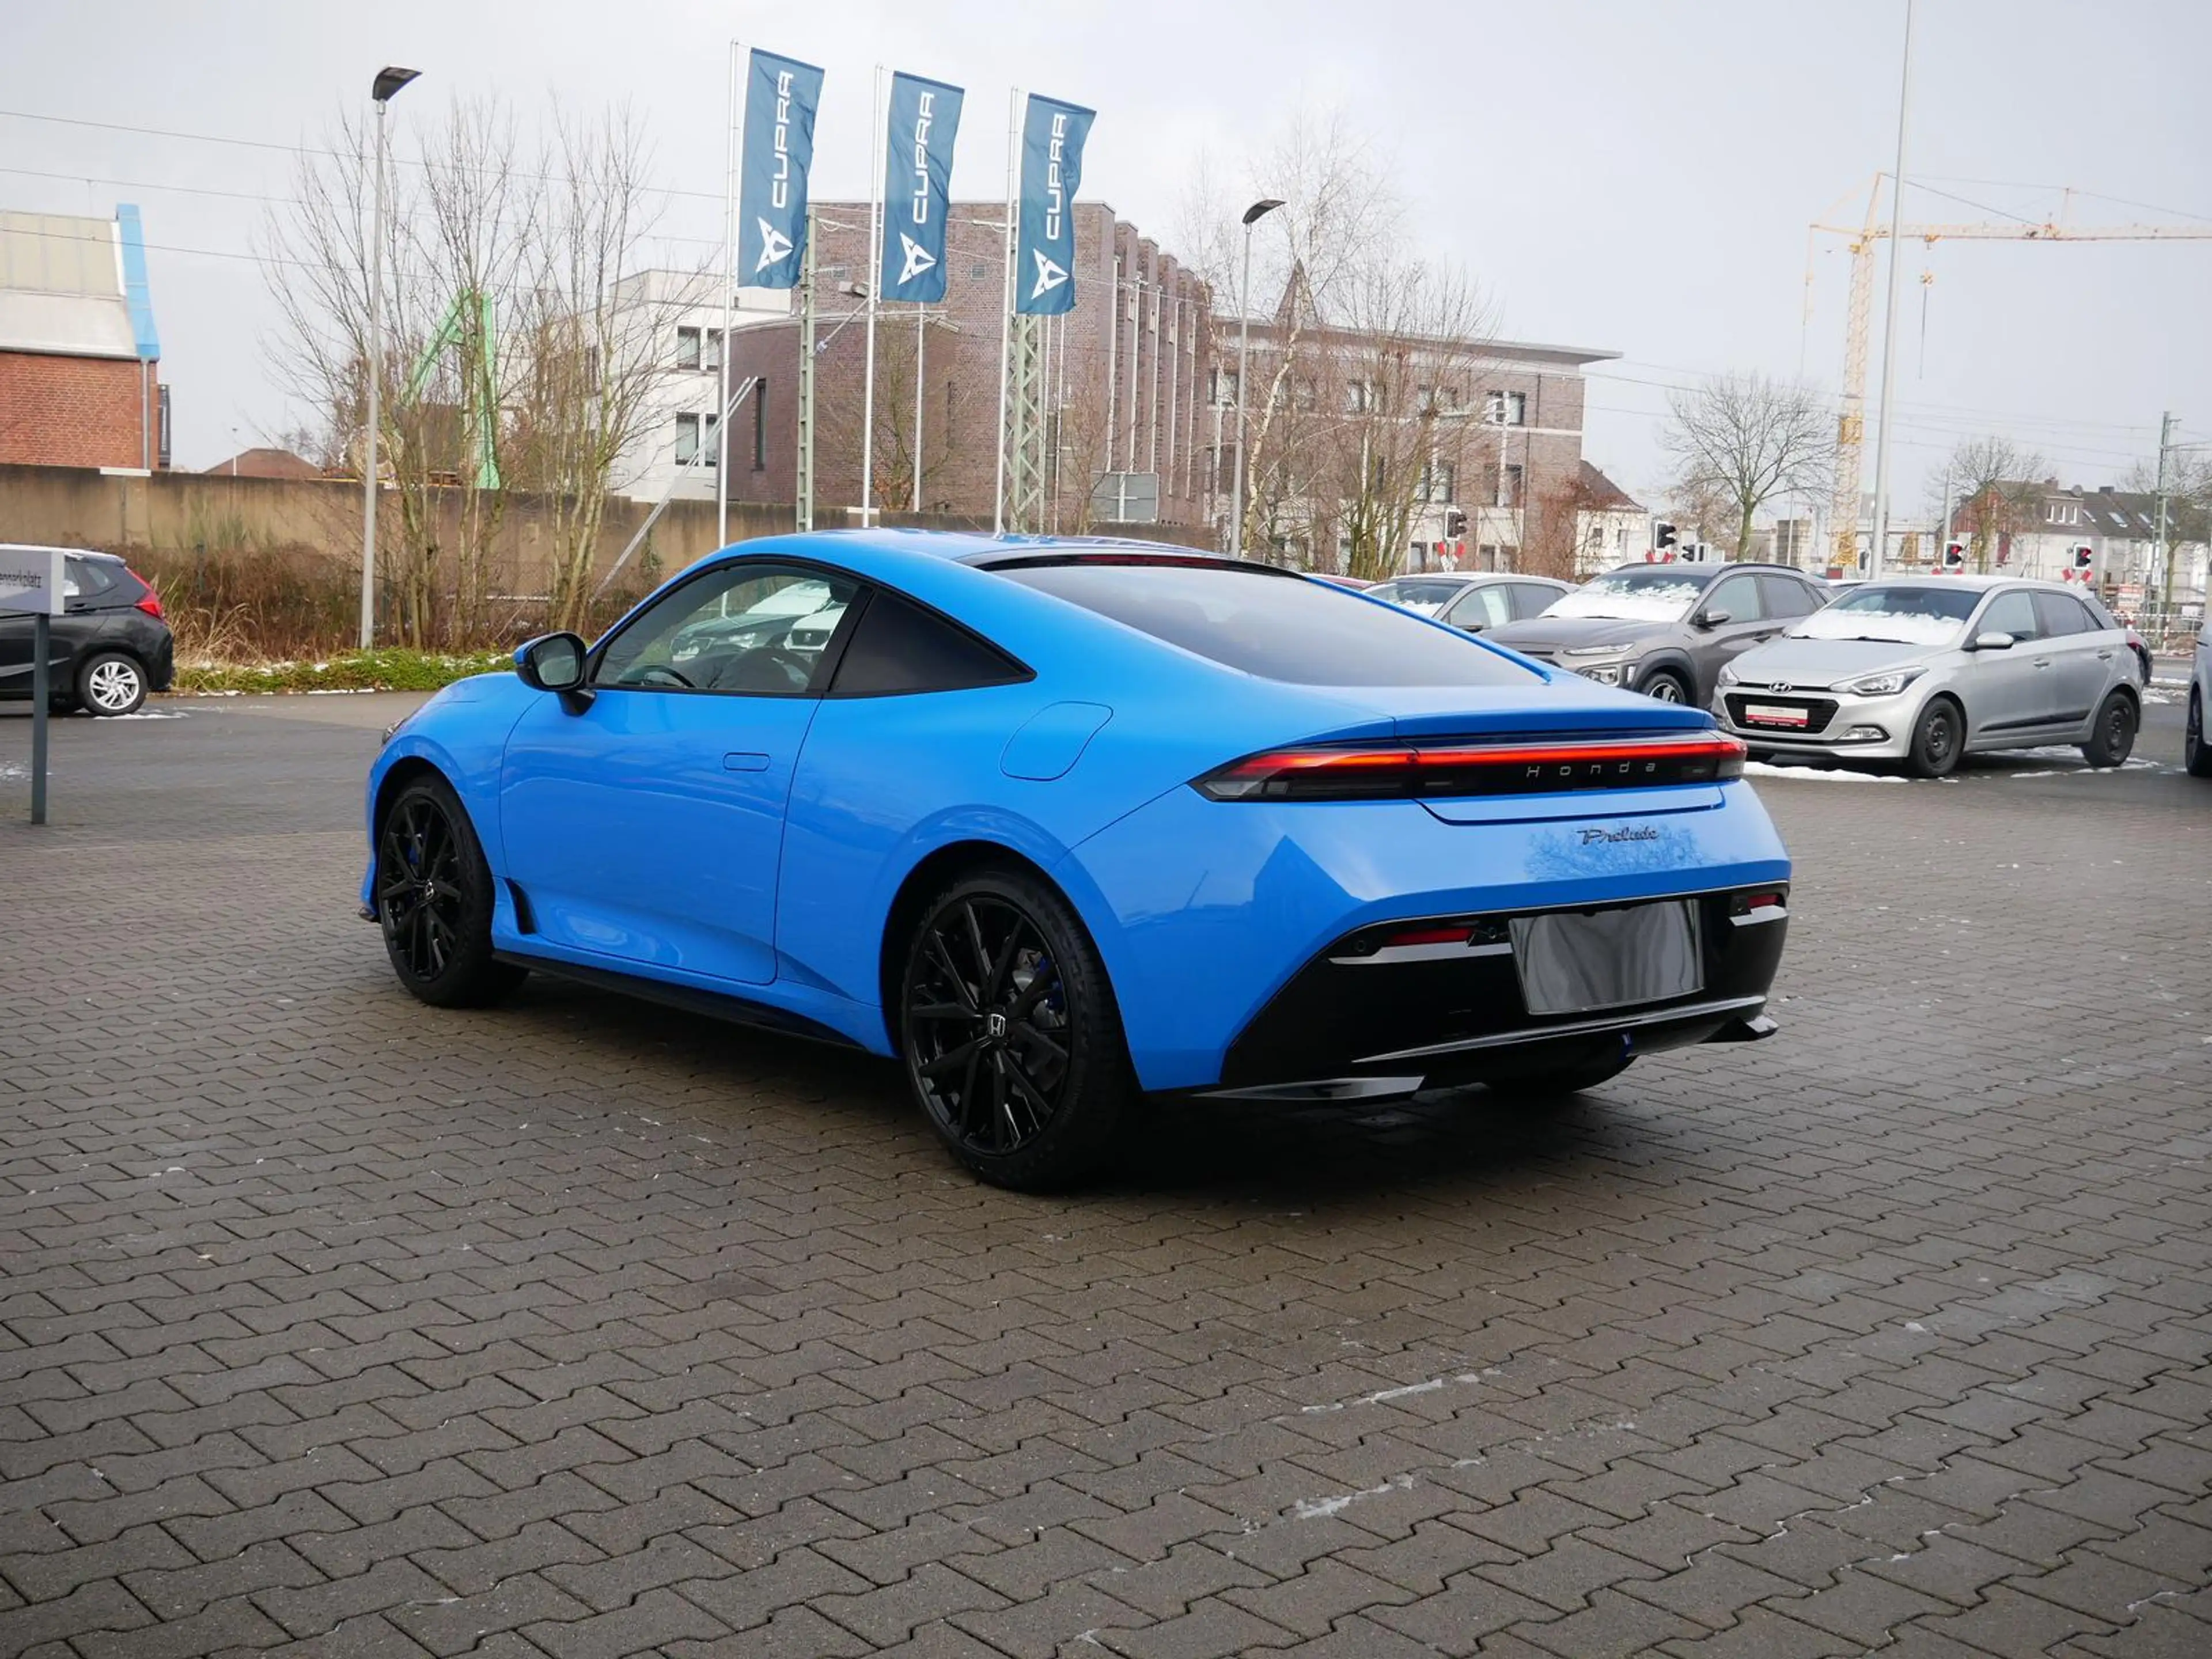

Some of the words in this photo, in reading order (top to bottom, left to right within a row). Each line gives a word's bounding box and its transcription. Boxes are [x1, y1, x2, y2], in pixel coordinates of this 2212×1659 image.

[772, 70, 794, 208] CUPRA
[913, 92, 934, 224] CUPRA
[1047, 113, 1067, 240] CUPRA
[1576, 826, 1660, 845] Prelude
